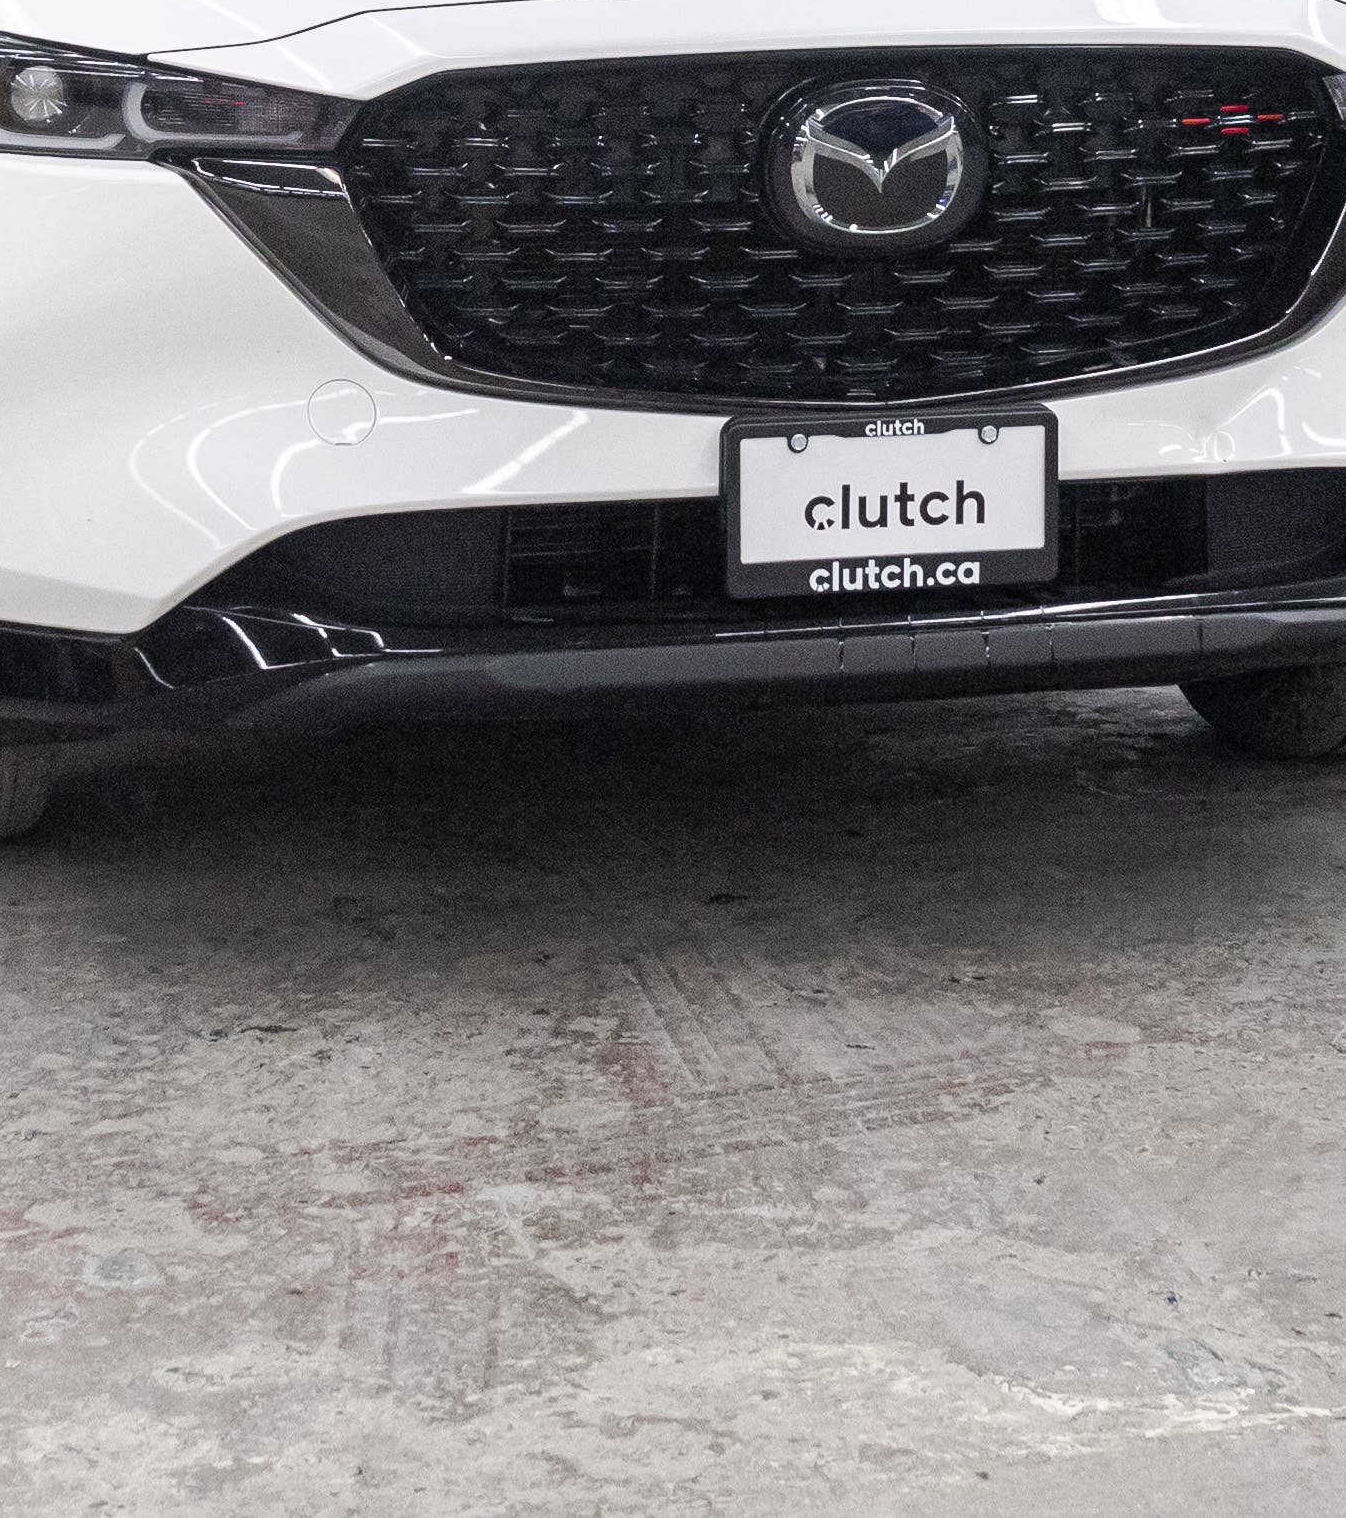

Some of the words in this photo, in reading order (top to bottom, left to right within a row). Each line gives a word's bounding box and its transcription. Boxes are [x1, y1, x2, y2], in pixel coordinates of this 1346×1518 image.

[865, 418, 925, 437] clutch
[804, 480, 985, 530] clutch
[809, 558, 980, 592] clutch.ca
